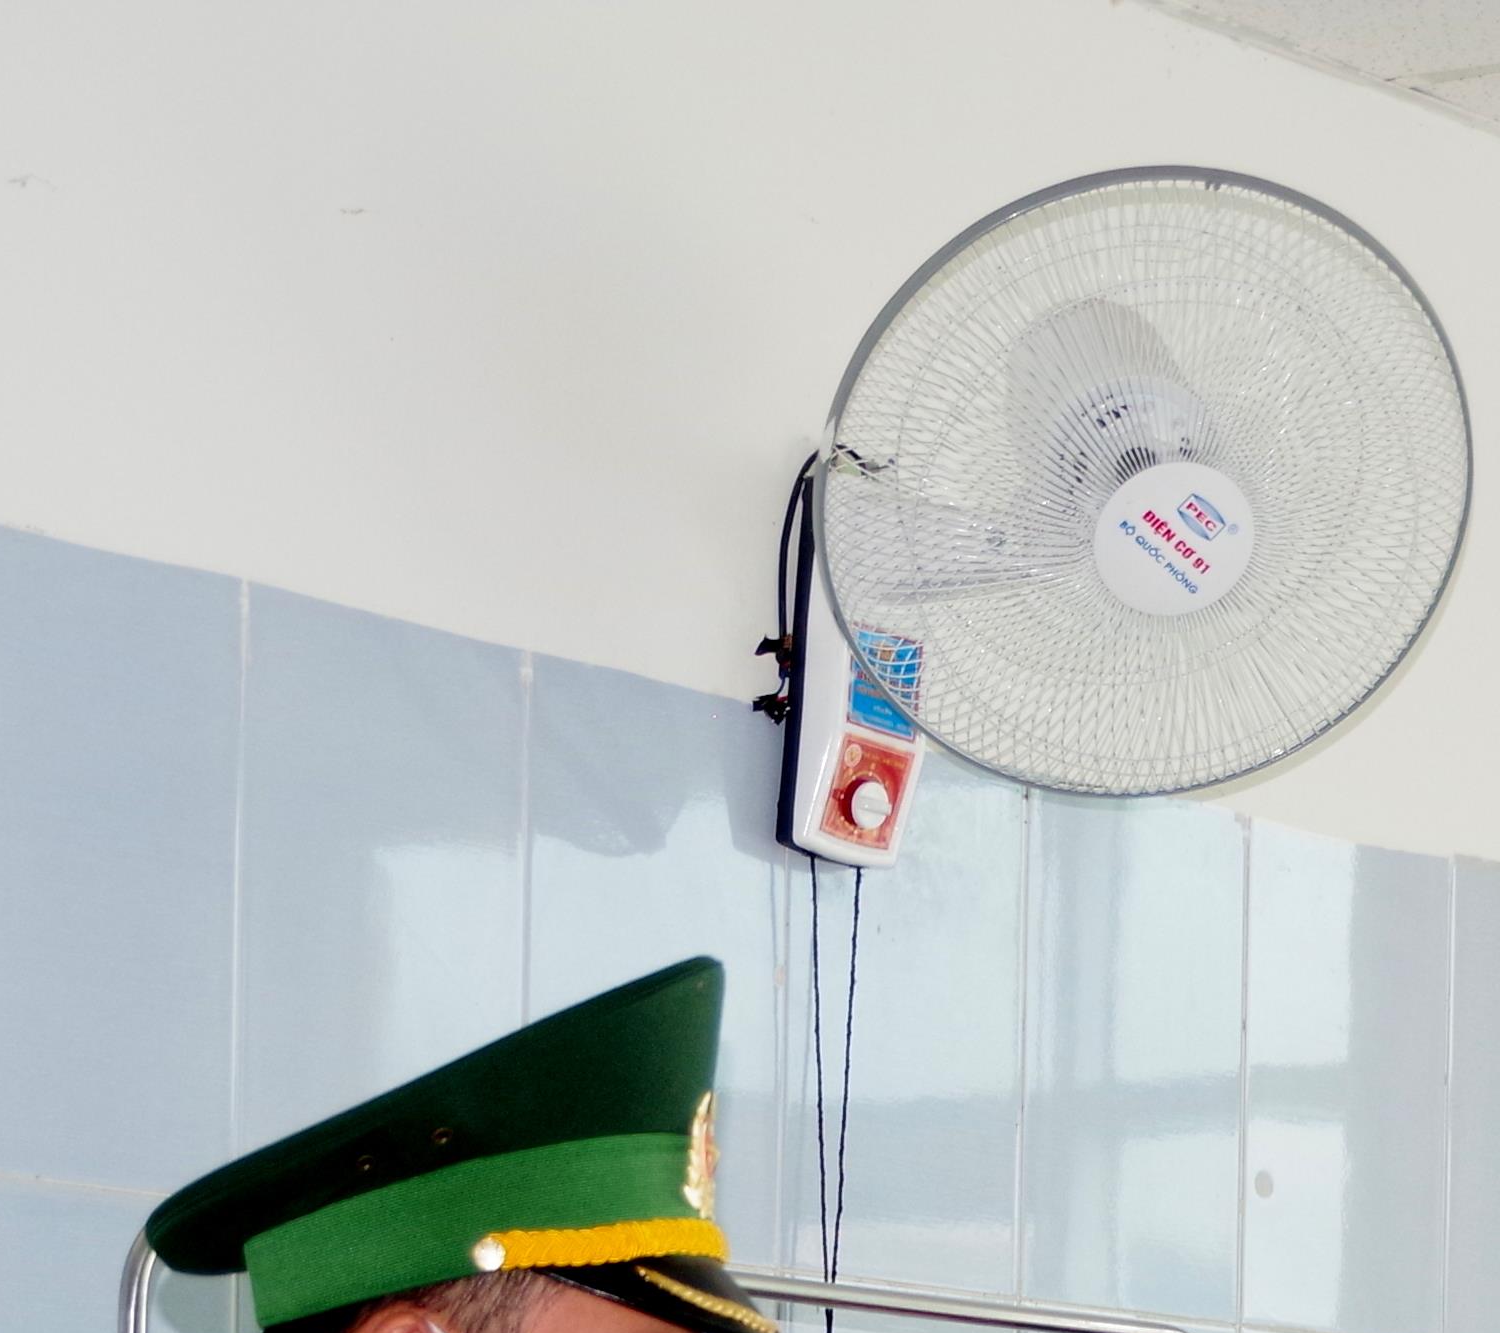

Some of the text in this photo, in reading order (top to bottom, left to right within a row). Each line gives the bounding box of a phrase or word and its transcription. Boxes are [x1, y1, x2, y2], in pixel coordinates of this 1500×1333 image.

[1142, 510, 1211, 575] ĐIỆN CƠ 91
[1185, 501, 1217, 532] PEC
[1119, 520, 1198, 594] BỘ QUỐC PHÒNG
